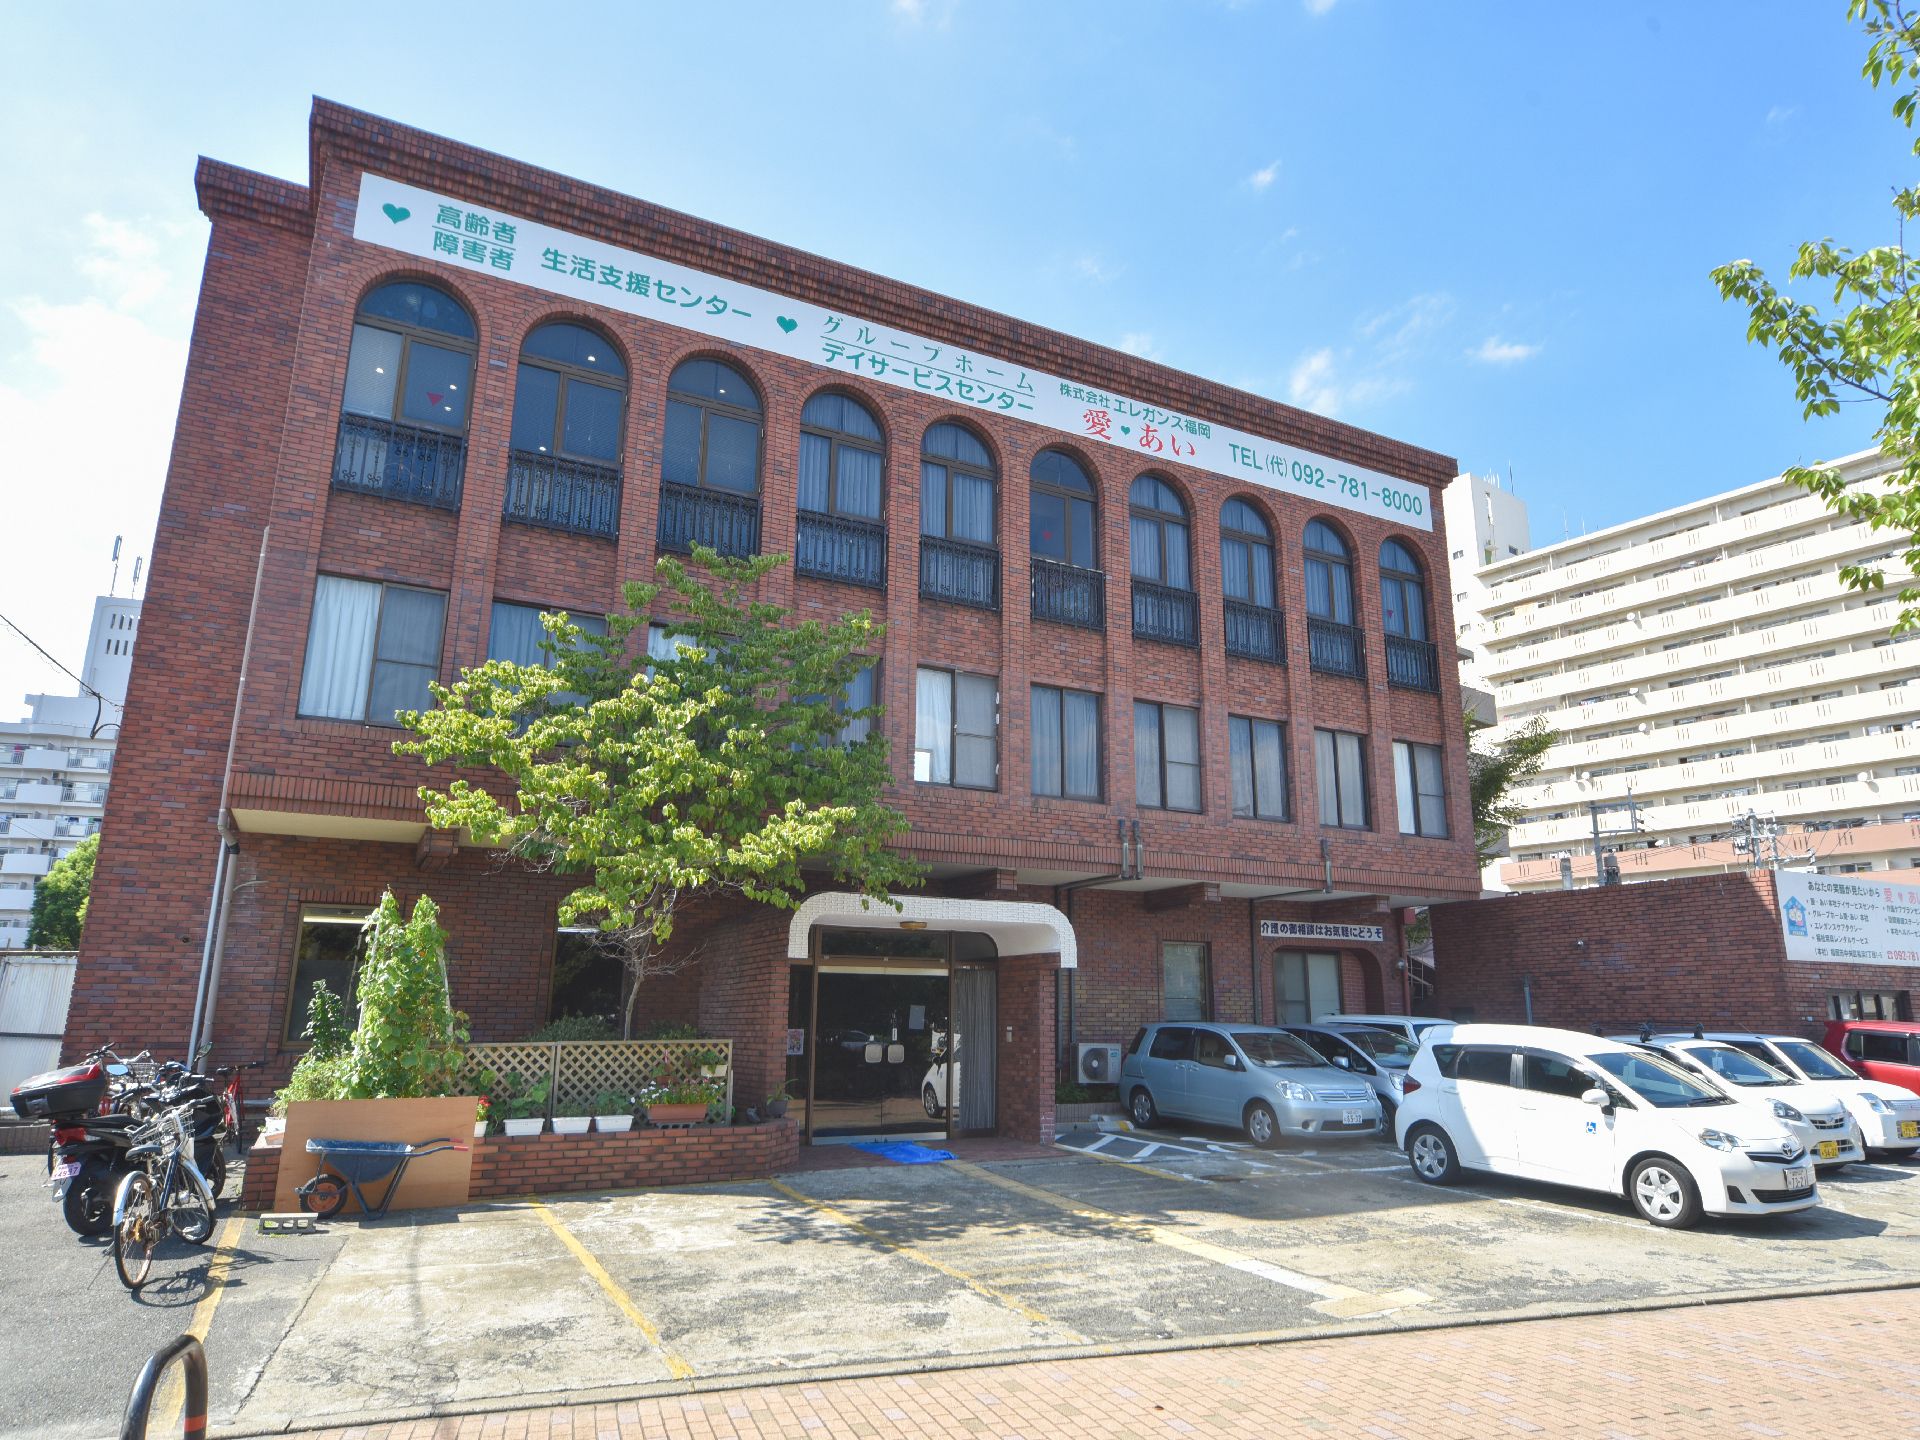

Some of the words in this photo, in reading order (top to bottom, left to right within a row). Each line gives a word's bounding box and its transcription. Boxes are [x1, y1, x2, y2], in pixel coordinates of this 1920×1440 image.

[435, 204, 517, 244] 高齢者
[432, 230, 514, 271] 障害者
[541, 247, 752, 319] 生活支援センター
[823, 315, 1034, 393] グループホーム
[1261, 922, 1382, 939] 介護の御相談はお気軽にどうぞ
